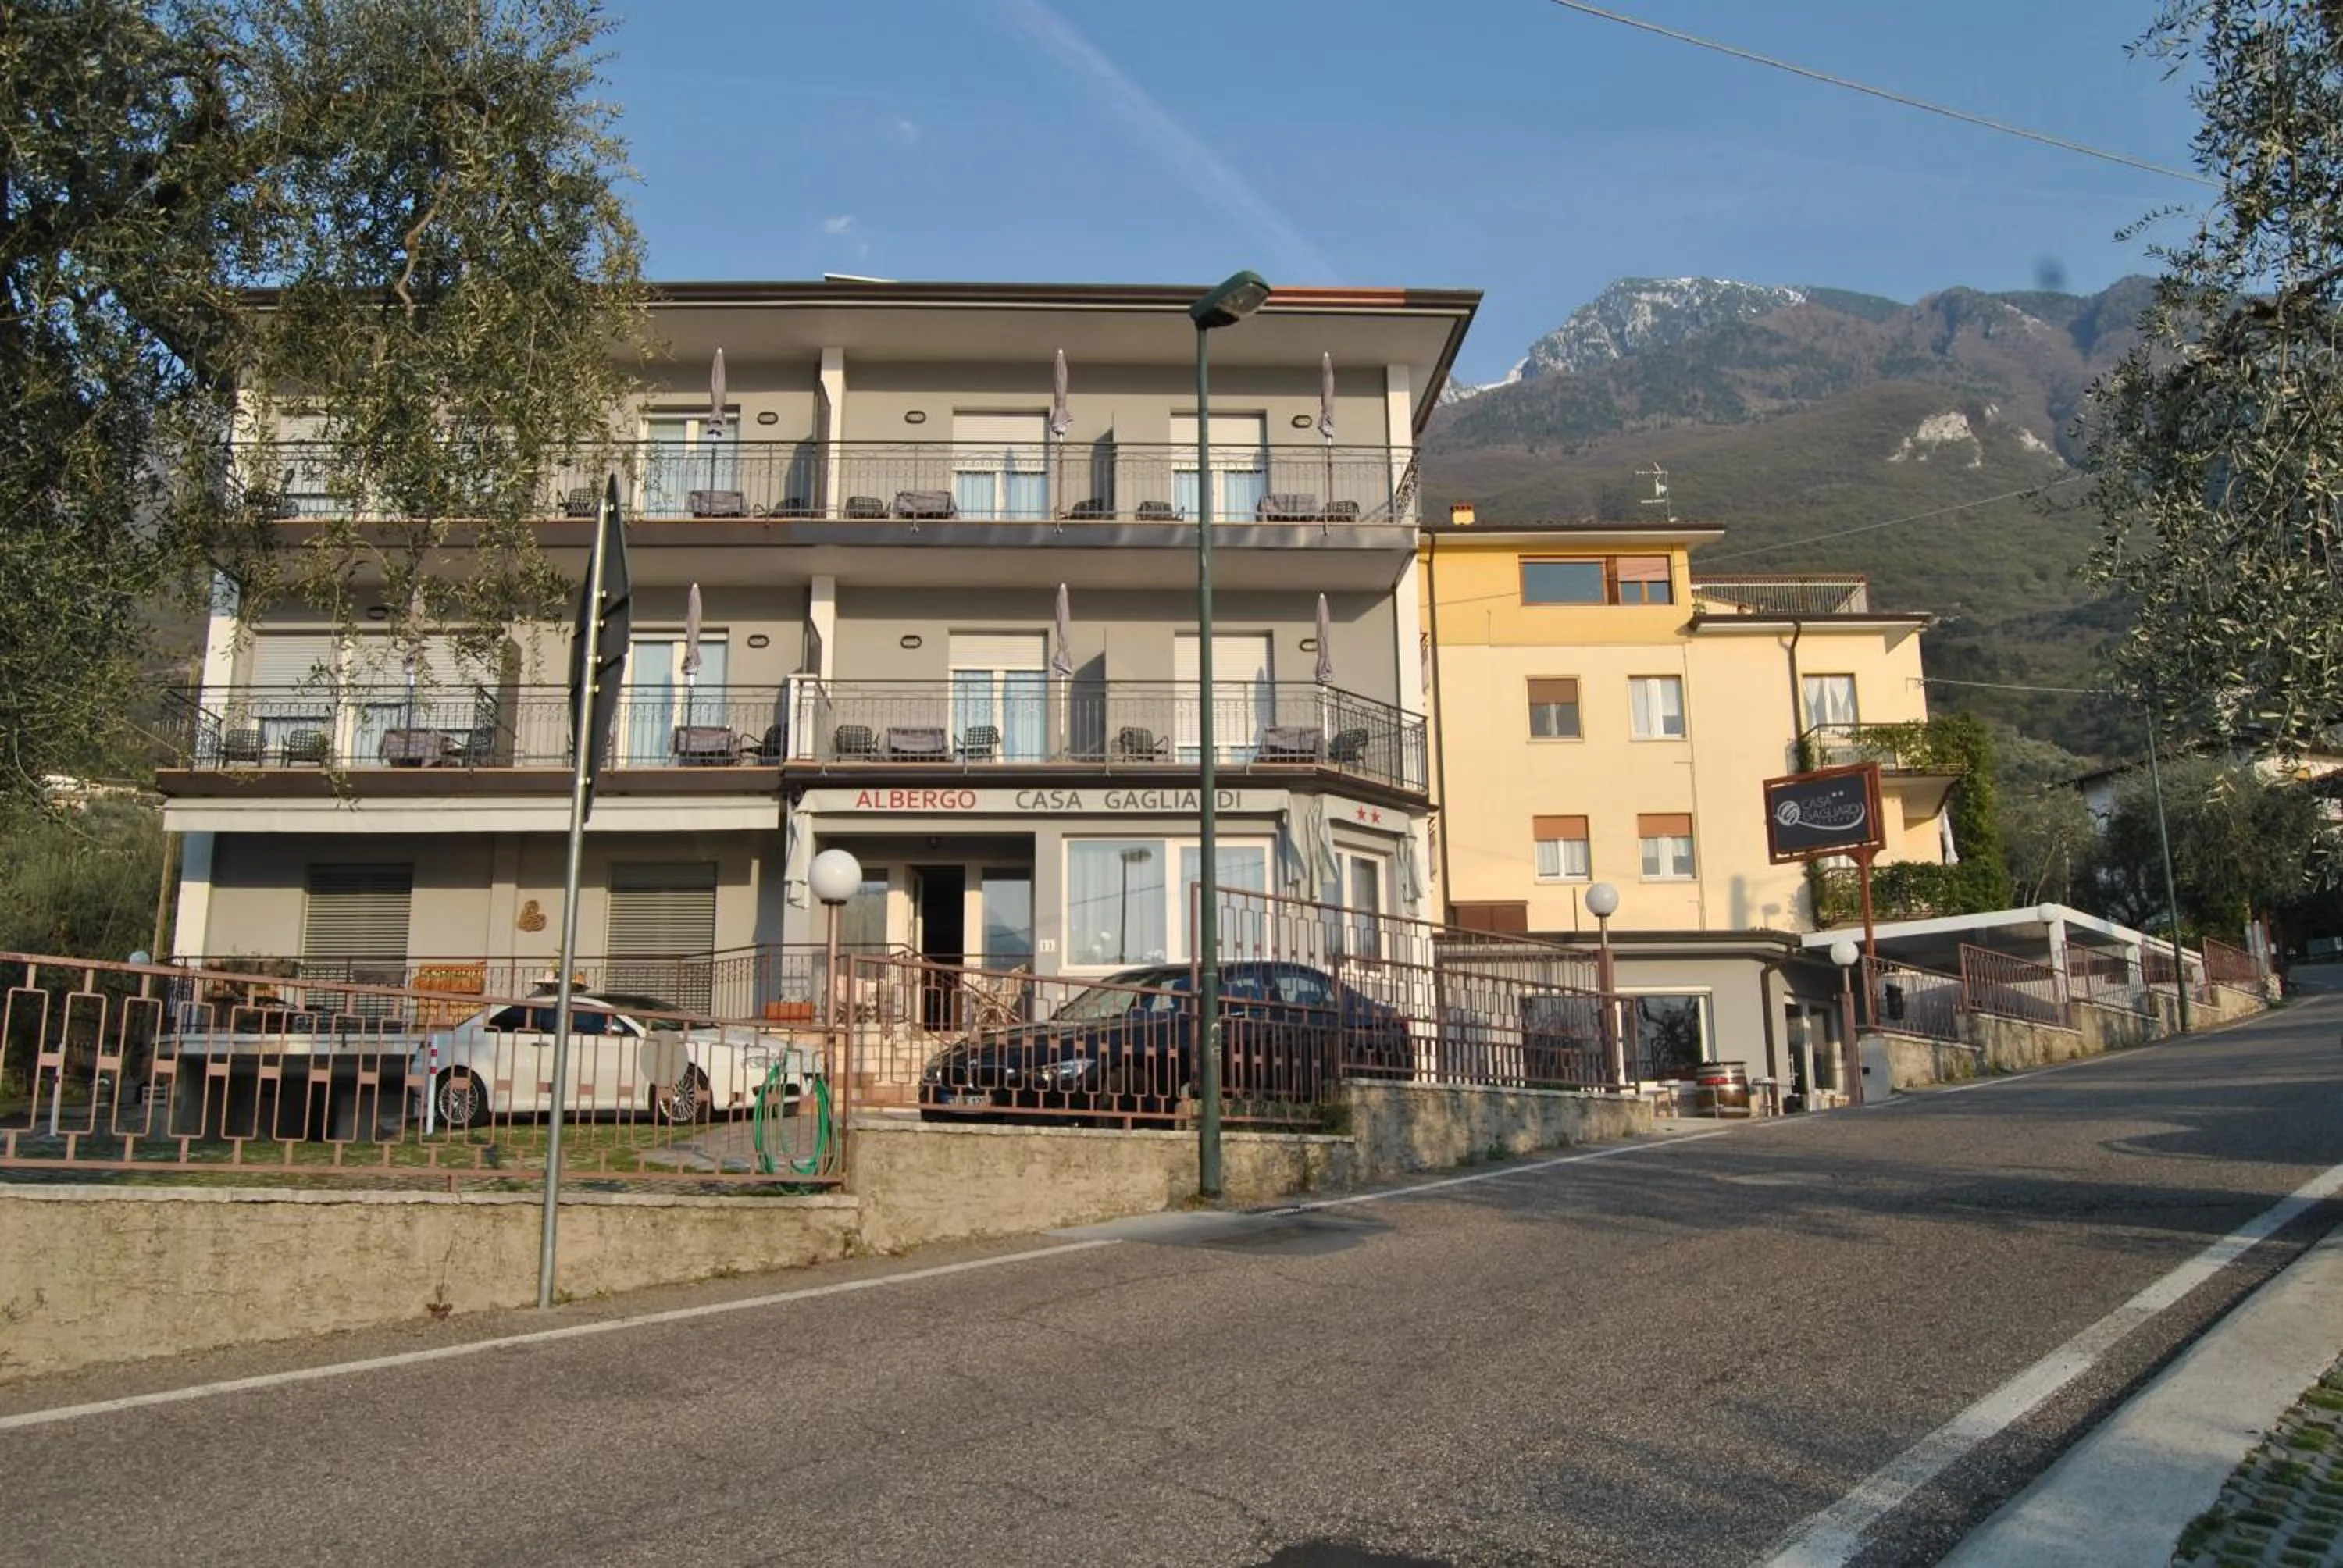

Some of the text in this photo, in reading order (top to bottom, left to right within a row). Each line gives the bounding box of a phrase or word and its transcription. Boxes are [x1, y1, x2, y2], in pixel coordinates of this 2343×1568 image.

[856, 789, 1240, 809] ALBERGO CASA GAGLIADI
[1801, 796, 1832, 809] CASA
